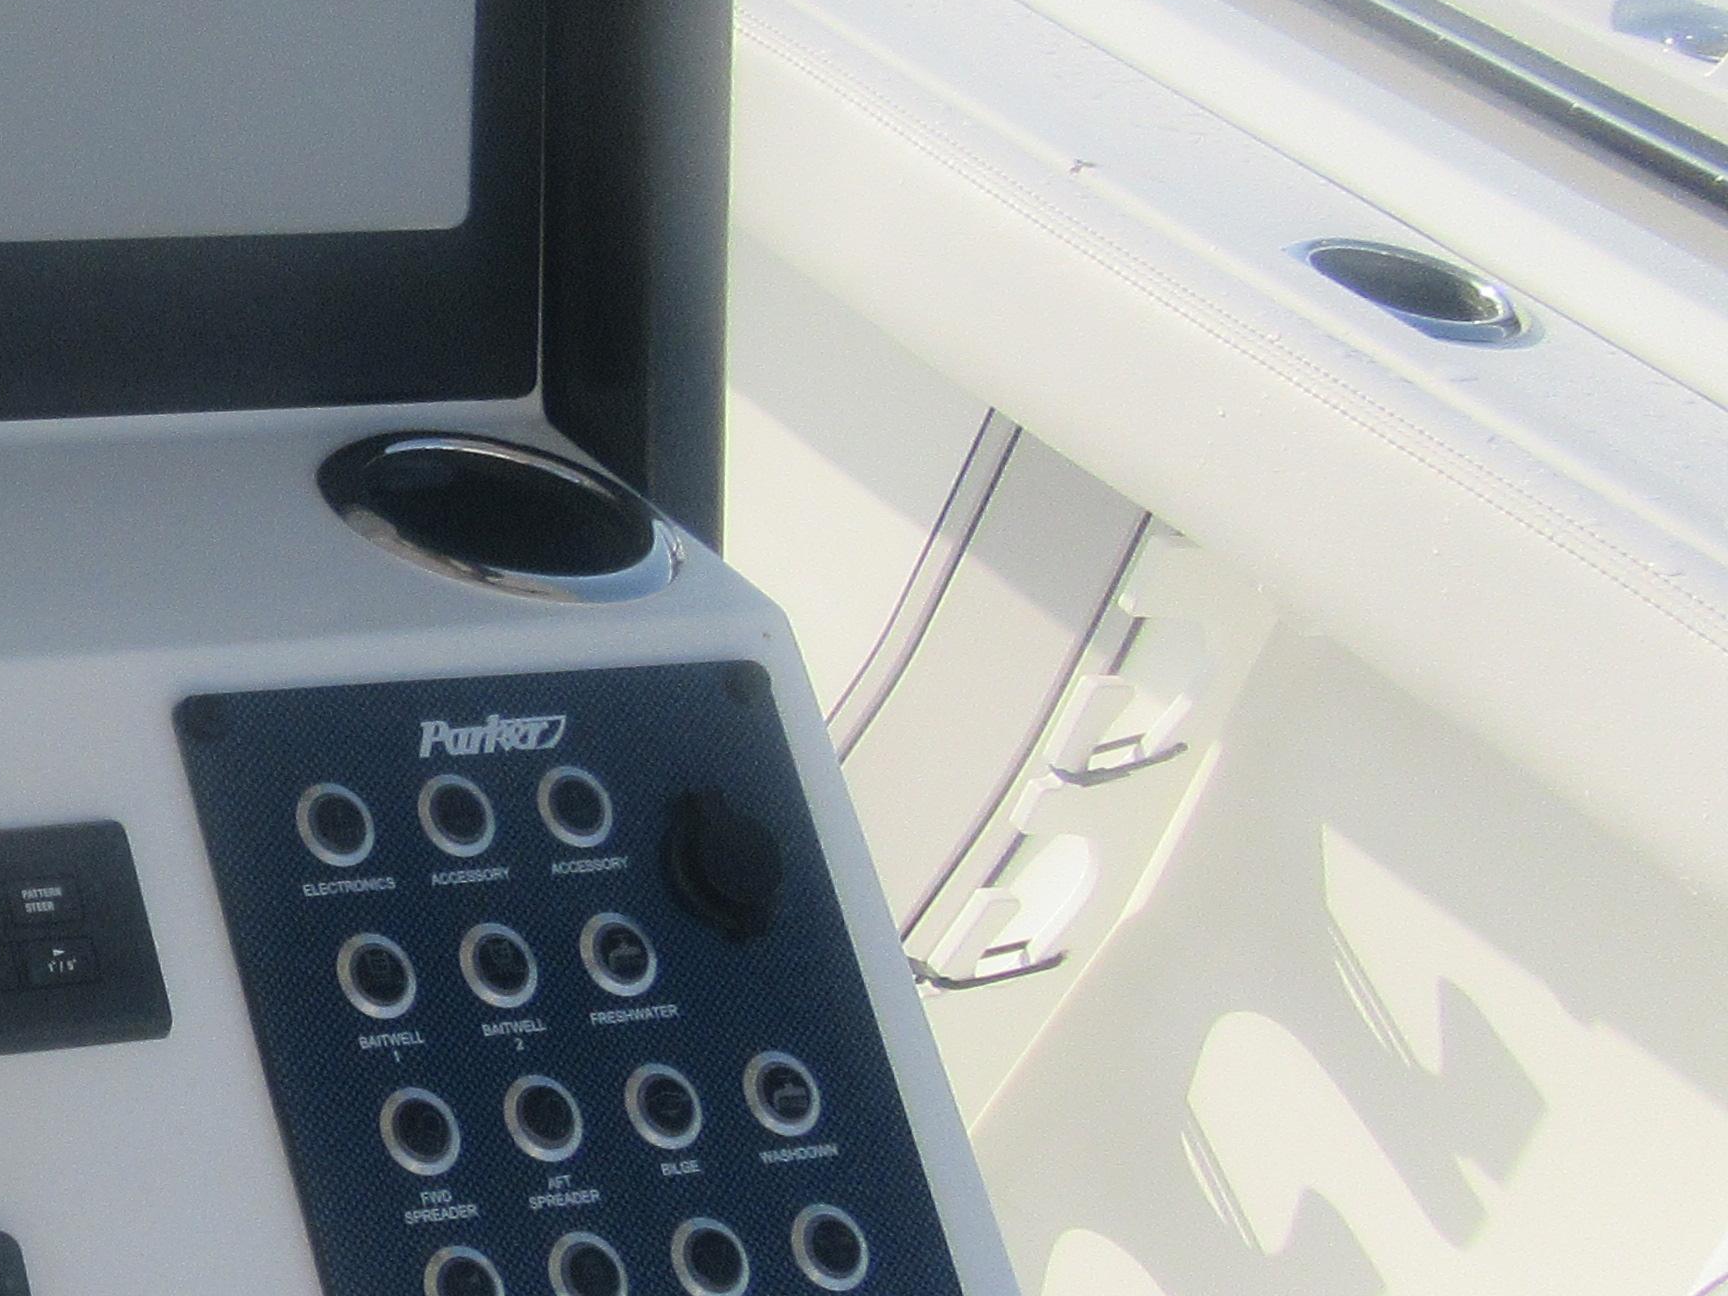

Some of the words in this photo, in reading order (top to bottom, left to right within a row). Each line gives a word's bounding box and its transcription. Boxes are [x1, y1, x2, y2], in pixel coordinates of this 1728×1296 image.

[418, 713, 567, 758] Parker
[551, 855, 629, 876] ACCESSORY
[302, 876, 397, 898] ELECTRONICS
[431, 866, 511, 887] ACCESSORY
[589, 1004, 682, 1026] FRESHWATER
[482, 1017, 547, 1038] BAITWELL
[358, 1030, 426, 1051] BAITWELL
[514, 1037, 525, 1052] 2
[393, 1050, 401, 1063] 1
[760, 1143, 840, 1165] WASHDOWN
[660, 1159, 702, 1176] BILGE
[547, 1174, 572, 1191] AFT
[419, 1189, 453, 1205] FWD
[528, 1189, 602, 1211] SPREADER
[403, 1203, 479, 1225] SPREADER
